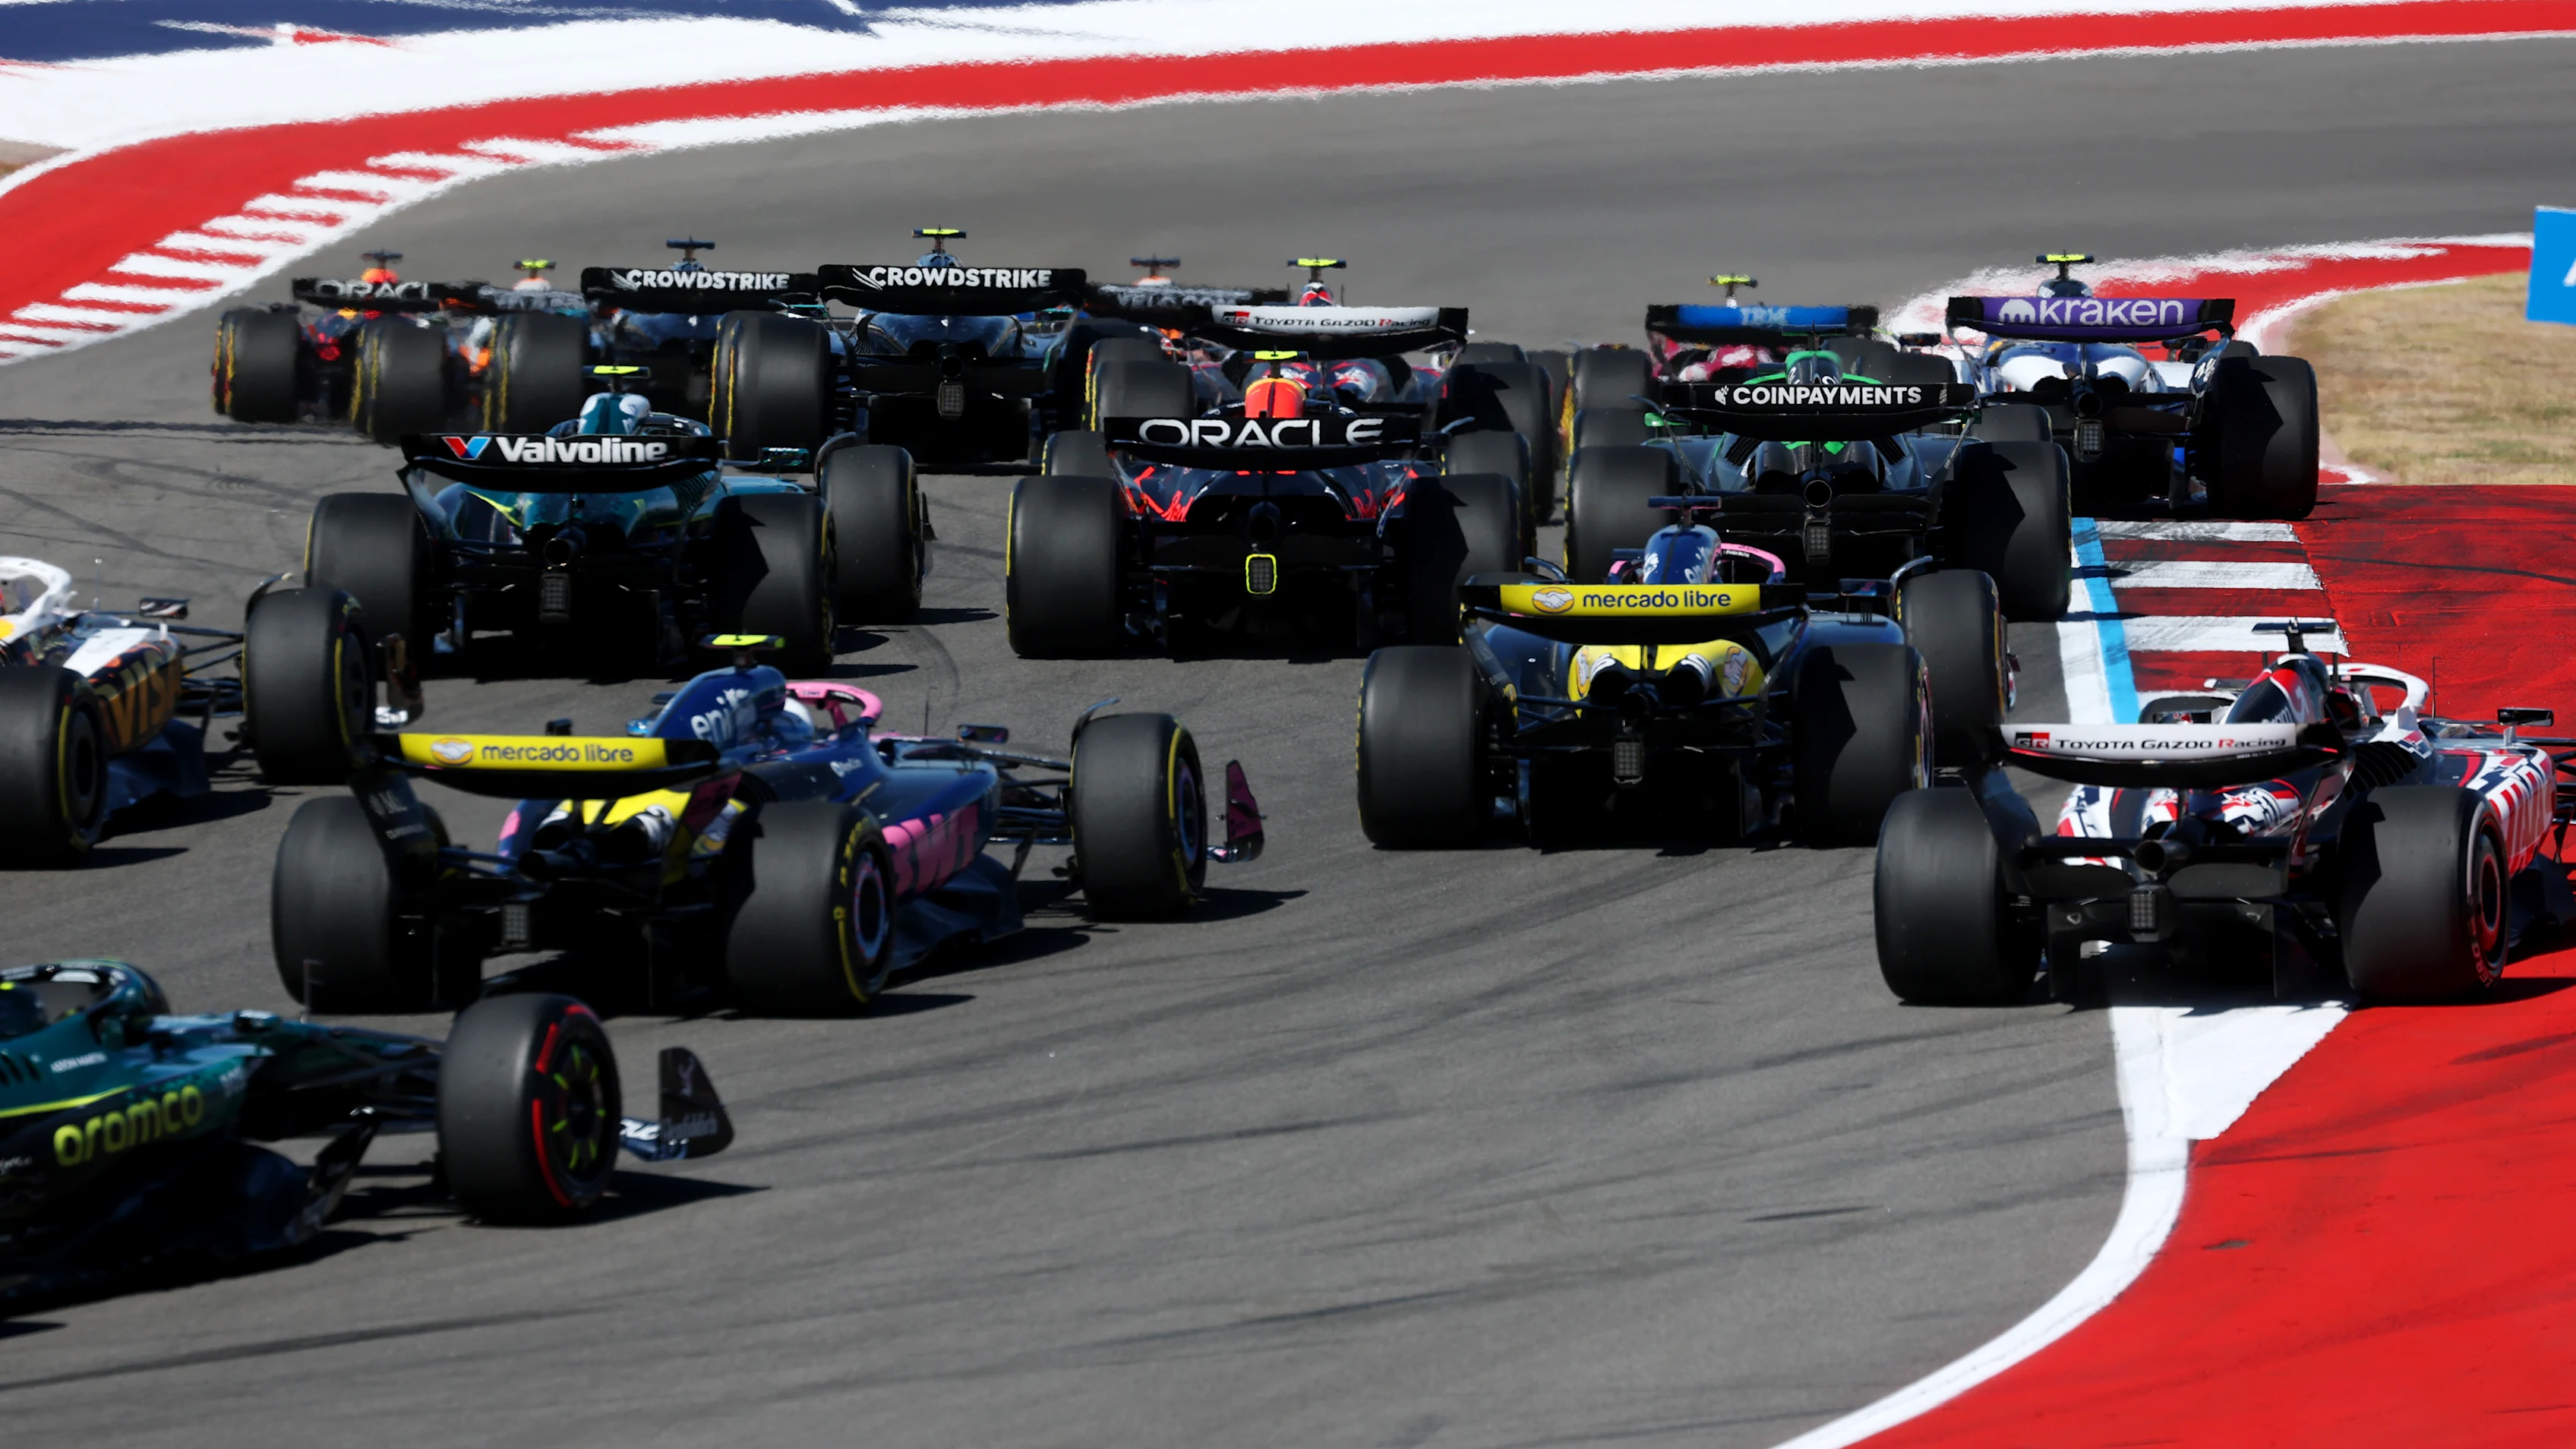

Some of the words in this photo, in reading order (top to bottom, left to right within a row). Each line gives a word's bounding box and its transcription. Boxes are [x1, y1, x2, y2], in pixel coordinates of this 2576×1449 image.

[626, 270, 791, 291] CROWDSTRIKE
[869, 267, 1053, 289] CROWDSTRIKE
[1254, 317, 1315, 327] TOYOTA
[1378, 317, 1432, 327] Racing
[2038, 299, 2185, 327] kraken
[1732, 386, 1922, 406] COINPAYMENTS
[1138, 418, 1384, 448] ORACLE
[495, 436, 667, 463] Valvoline
[1583, 591, 1679, 608] mercado
[1684, 591, 1732, 608] libre
[481, 745, 579, 762] mercado
[585, 745, 634, 762] libre
[2056, 739, 2134, 750] TOYOTA
[2141, 740, 2212, 750] GAZOO
[2218, 738, 2287, 750] Racing
